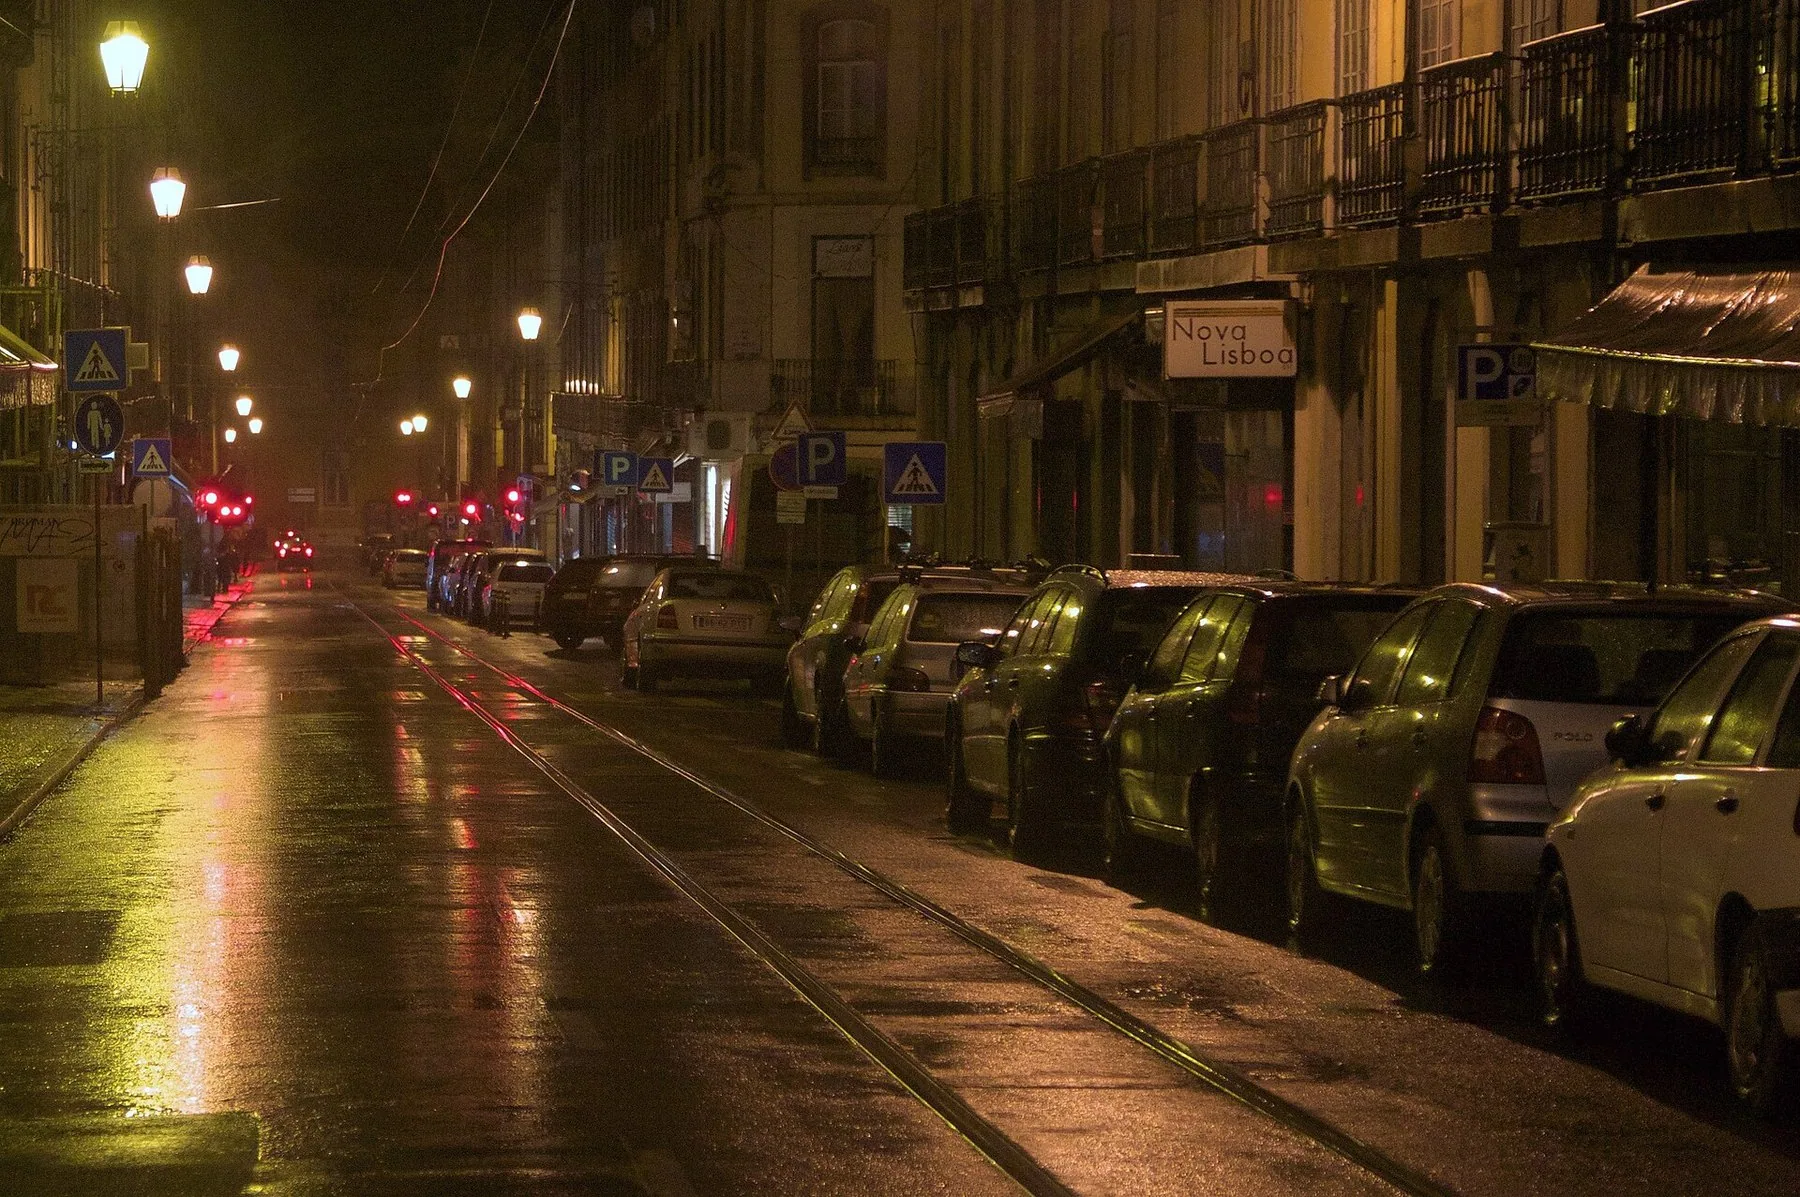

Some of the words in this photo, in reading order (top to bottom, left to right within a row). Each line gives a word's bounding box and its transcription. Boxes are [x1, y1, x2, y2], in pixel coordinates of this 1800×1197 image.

[1172, 317, 1247, 341] Nova
[1202, 341, 1294, 366] Lisboa
[1466, 348, 1504, 400] P
[610, 456, 631, 482] P
[807, 437, 836, 481] P
[1553, 731, 1594, 742] POLO
